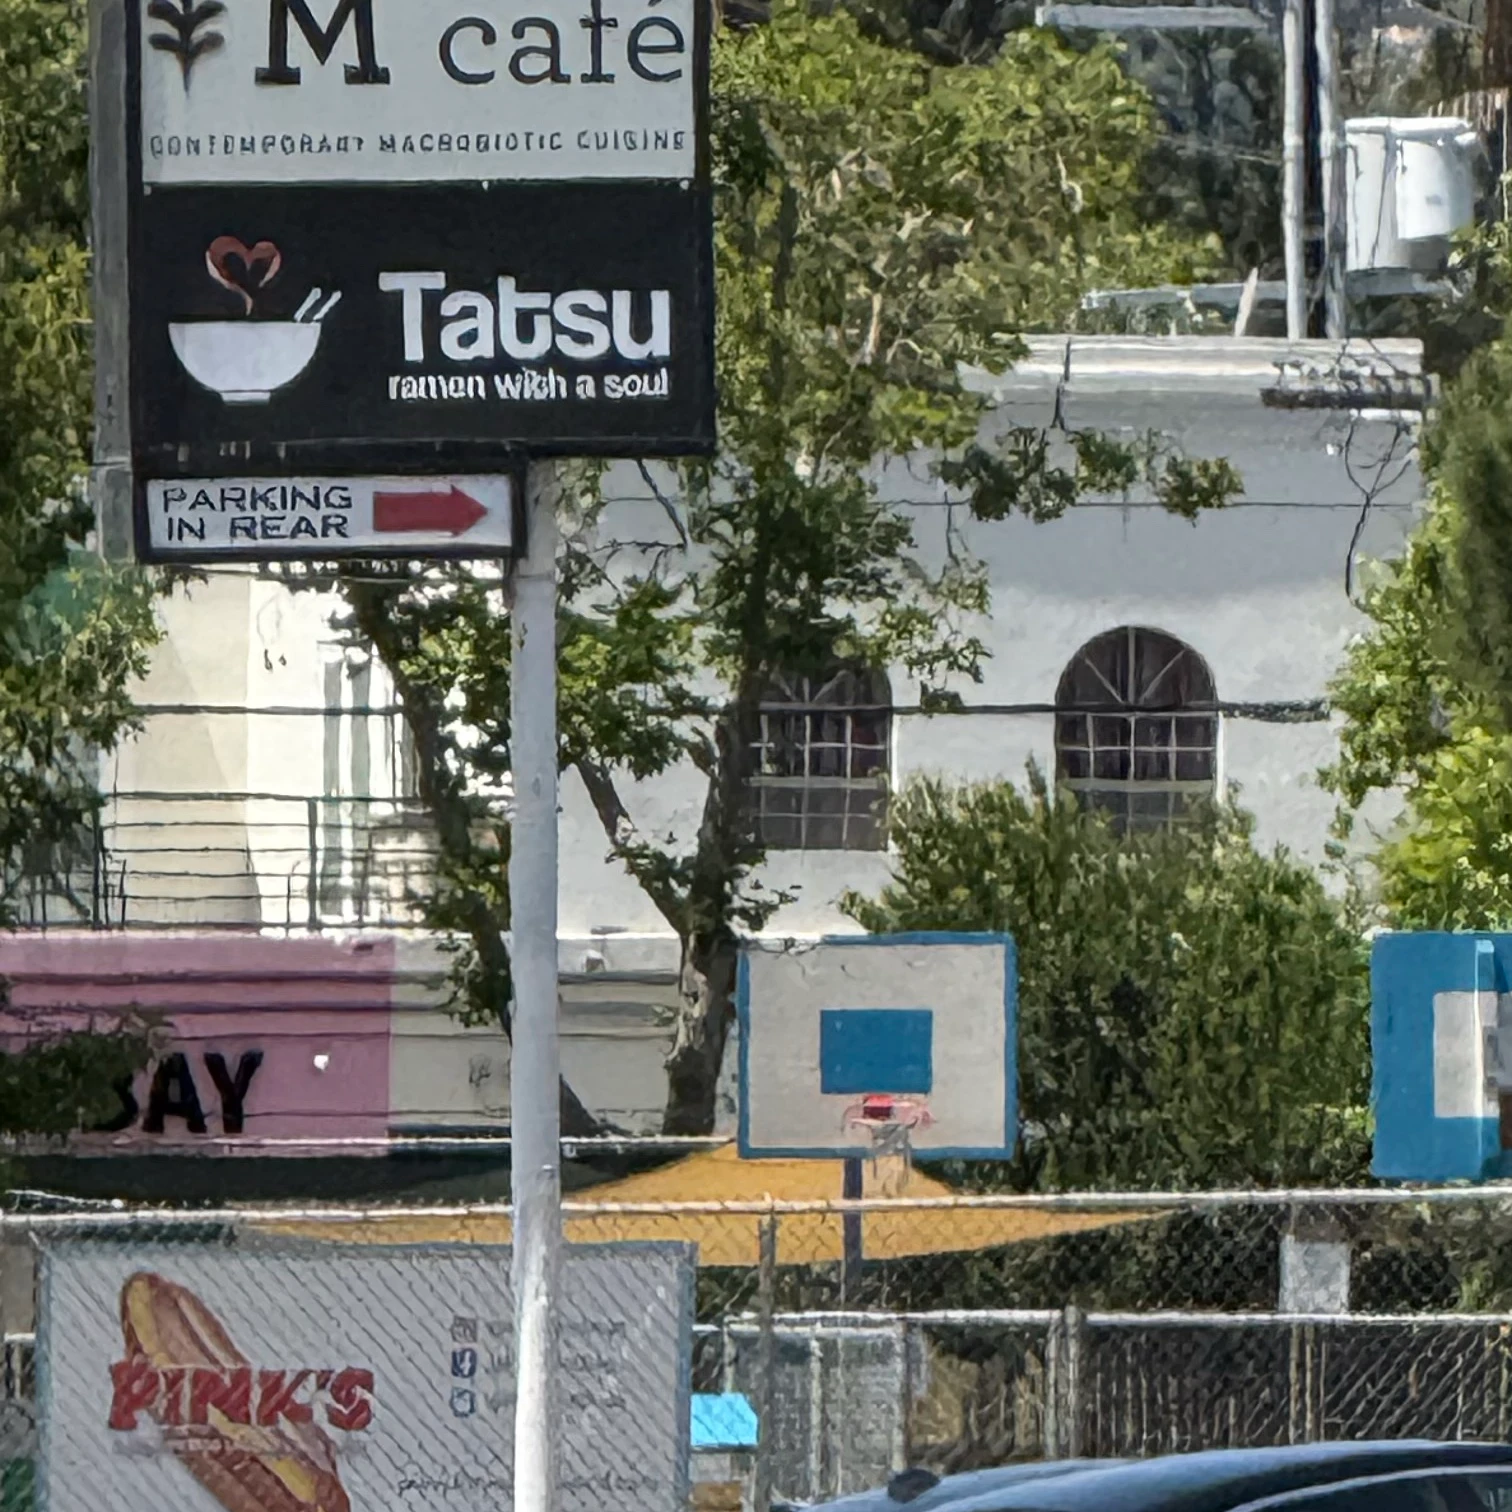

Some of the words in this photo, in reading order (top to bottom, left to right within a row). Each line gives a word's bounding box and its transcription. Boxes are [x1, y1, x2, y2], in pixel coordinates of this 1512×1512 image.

[255, 0, 390, 84] M
[439, 0, 684, 84] café
[577, 130, 685, 151] CUISINE
[379, 272, 670, 361] Tatsu
[388, 374, 485, 399] ramen
[494, 367, 567, 399] with
[575, 374, 596, 399] a
[604, 368, 668, 397] soul
[163, 485, 352, 513] PARKING
[167, 517, 205, 541] IN
[229, 514, 349, 541] REAR
[108, 1360, 375, 1431] PINK'S
